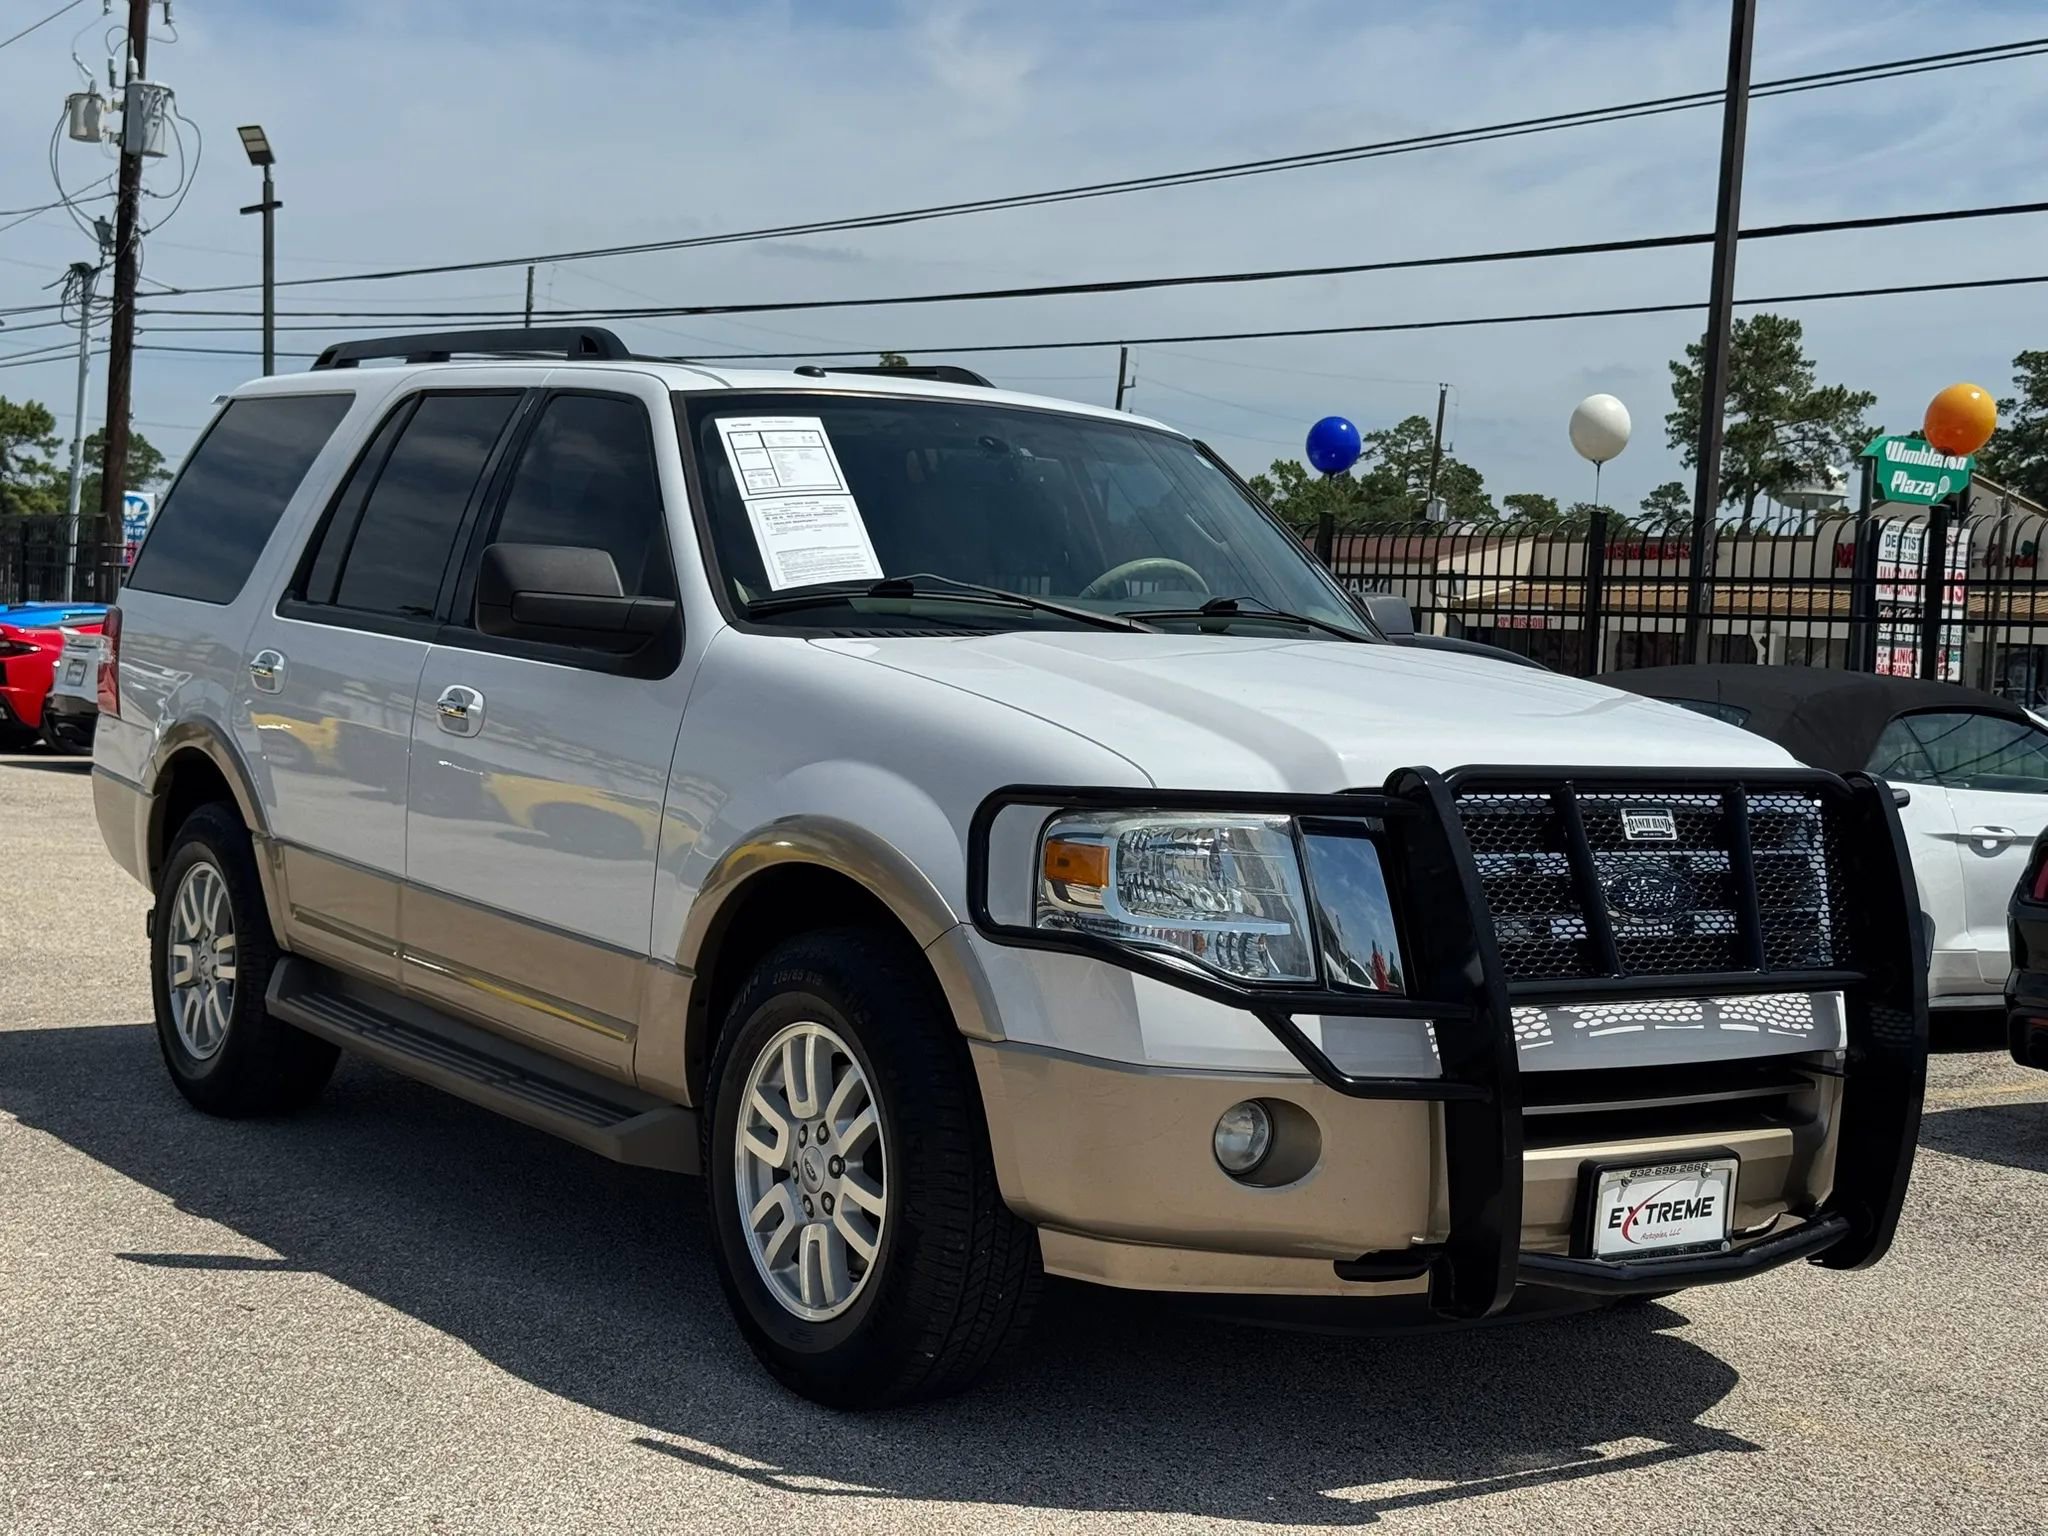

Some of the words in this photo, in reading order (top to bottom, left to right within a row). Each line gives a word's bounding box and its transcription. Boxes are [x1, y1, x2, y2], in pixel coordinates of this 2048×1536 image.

[1891, 470, 1936, 496] Plaza
[1885, 533, 1922, 551] DETIS
[1513, 616, 1553, 629] DISOUT
[1891, 648, 1919, 665] LINIC
[1892, 664, 1918, 677] RAFA
[1627, 817, 1651, 832] RANCH
[1651, 817, 1672, 832] HAND
[1608, 1196, 1715, 1229] EXTREME
